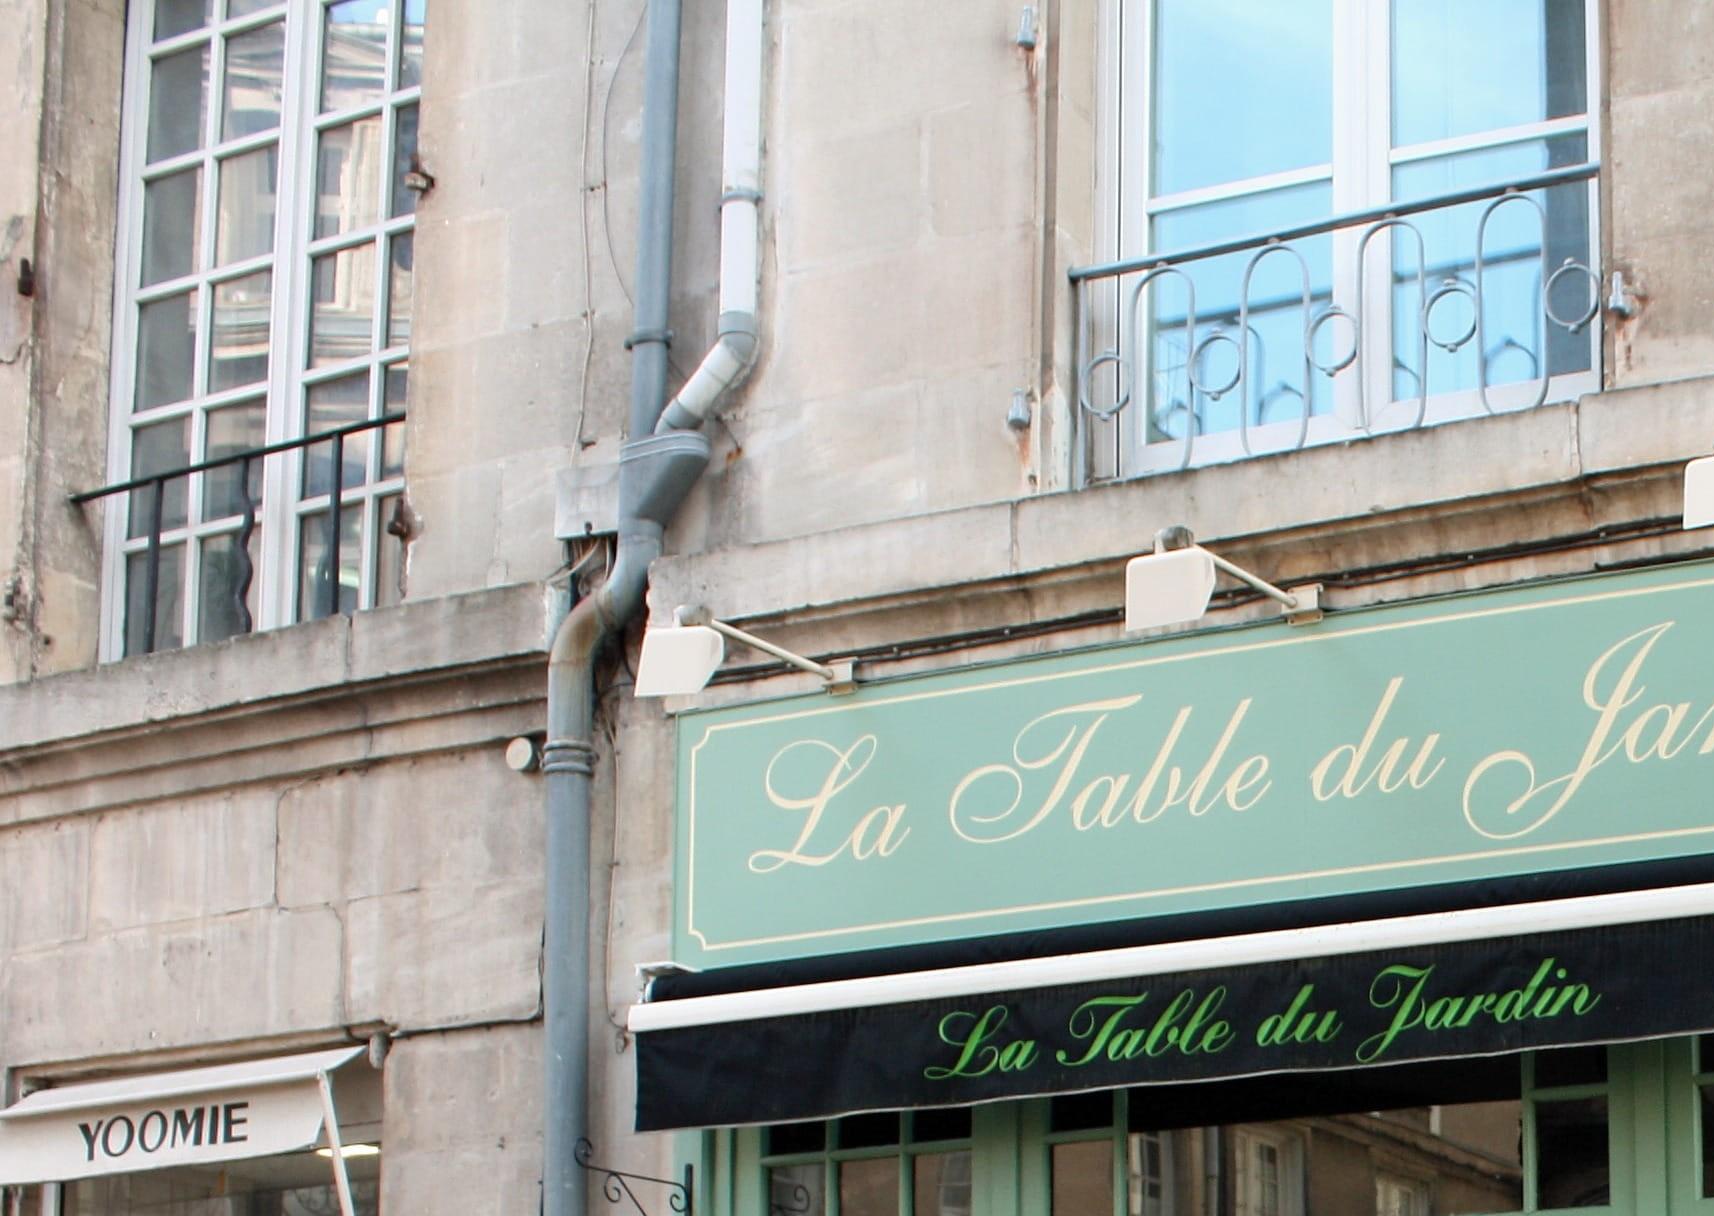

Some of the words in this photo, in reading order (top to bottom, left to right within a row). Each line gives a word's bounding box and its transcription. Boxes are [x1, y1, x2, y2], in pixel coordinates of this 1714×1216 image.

[748, 734, 911, 873] La
[949, 694, 1273, 844] Table
[1310, 676, 1445, 801] du
[924, 1003, 1039, 1080] La
[1056, 984, 1236, 1066] Table
[1256, 983, 1344, 1045] du
[1356, 956, 1601, 1064] Jardin
[79, 1101, 249, 1161] YOOMIE
